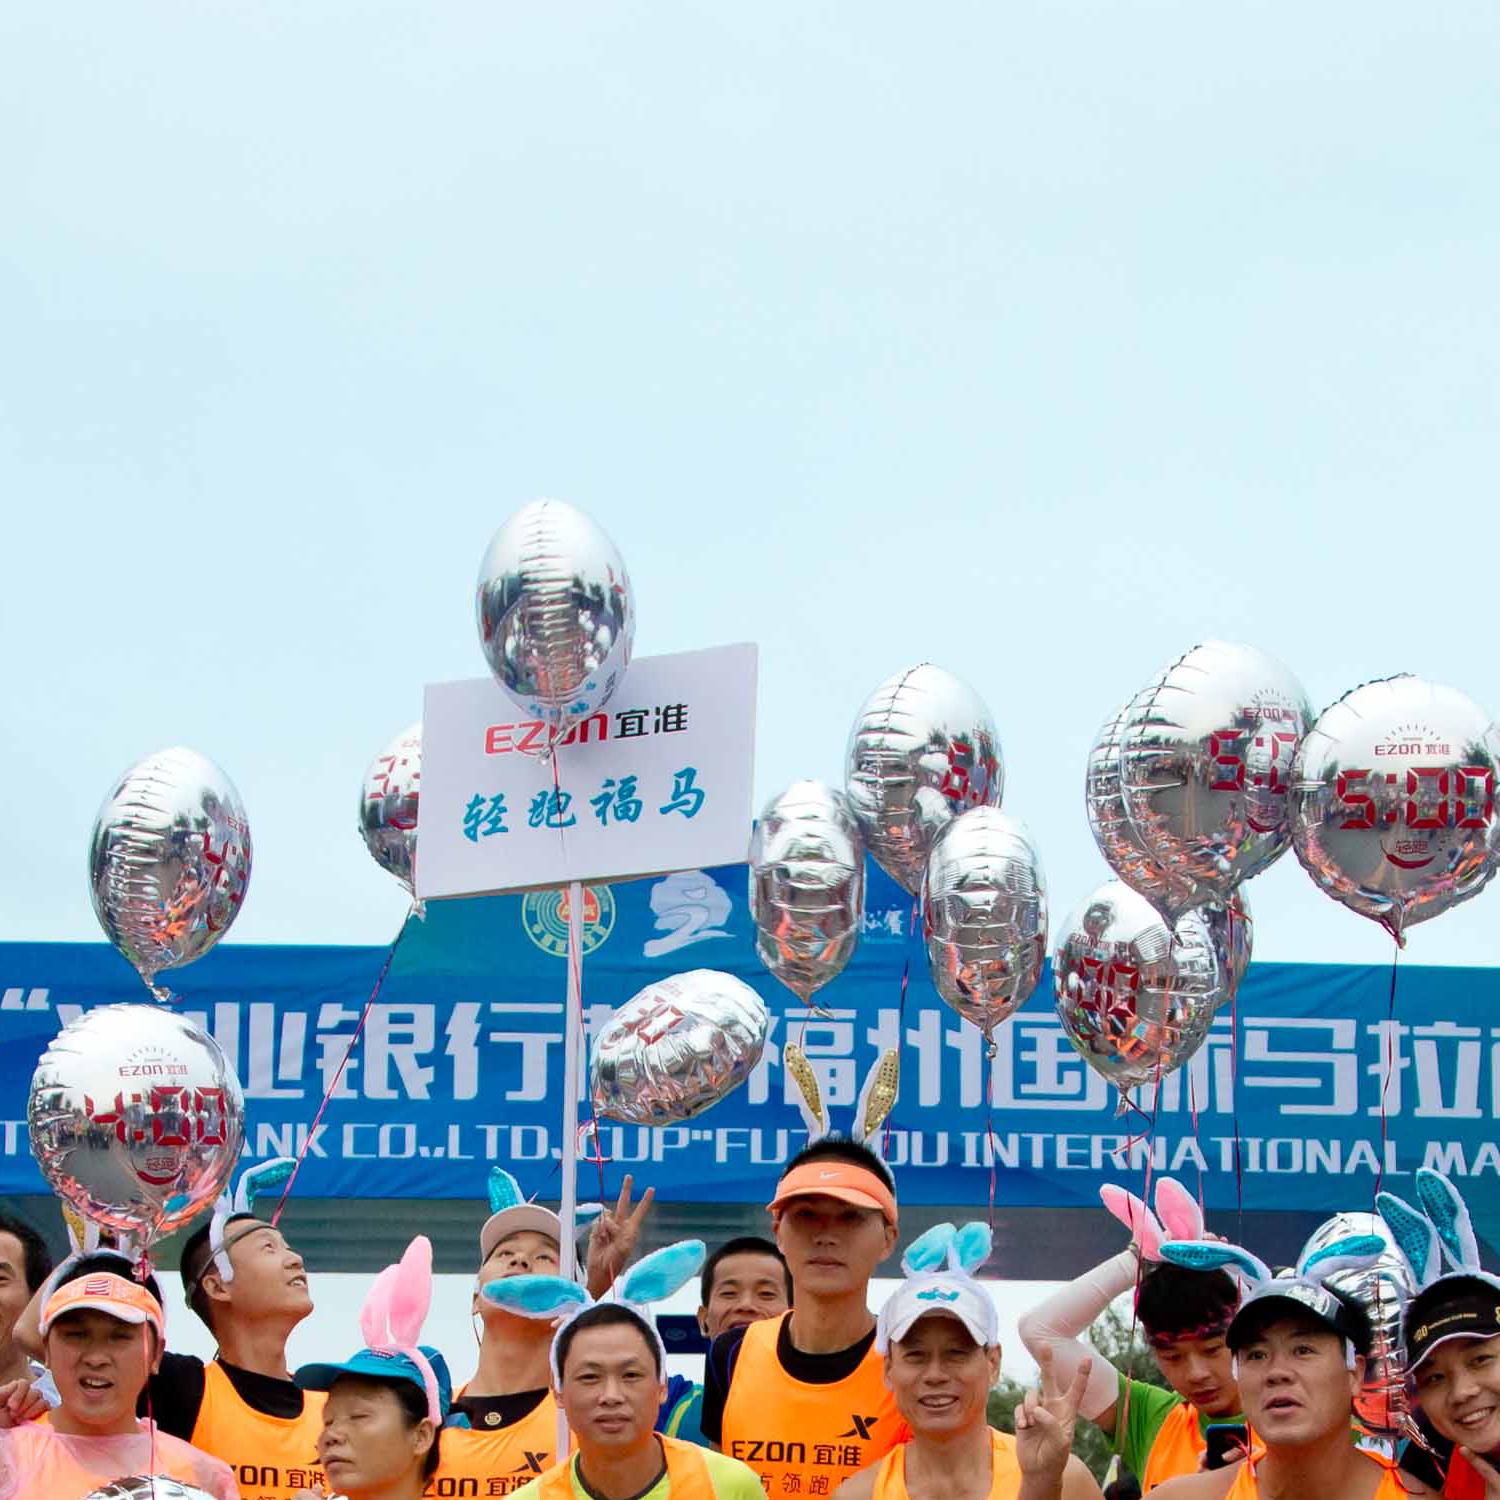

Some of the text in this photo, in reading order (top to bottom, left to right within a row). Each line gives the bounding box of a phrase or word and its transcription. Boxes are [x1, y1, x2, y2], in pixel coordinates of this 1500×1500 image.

[613, 702, 690, 740] 宜准
[1373, 742, 1422, 757] EZON
[462, 766, 706, 843] 轻跑福马
[1337, 767, 1494, 830] 5:00
[119, 1065, 164, 1078] EZON
[84, 1085, 227, 1147] 4:00
[960, 1131, 1411, 1177] INTERNATIONAL
[731, 1440, 862, 1467] EZON 宜准
